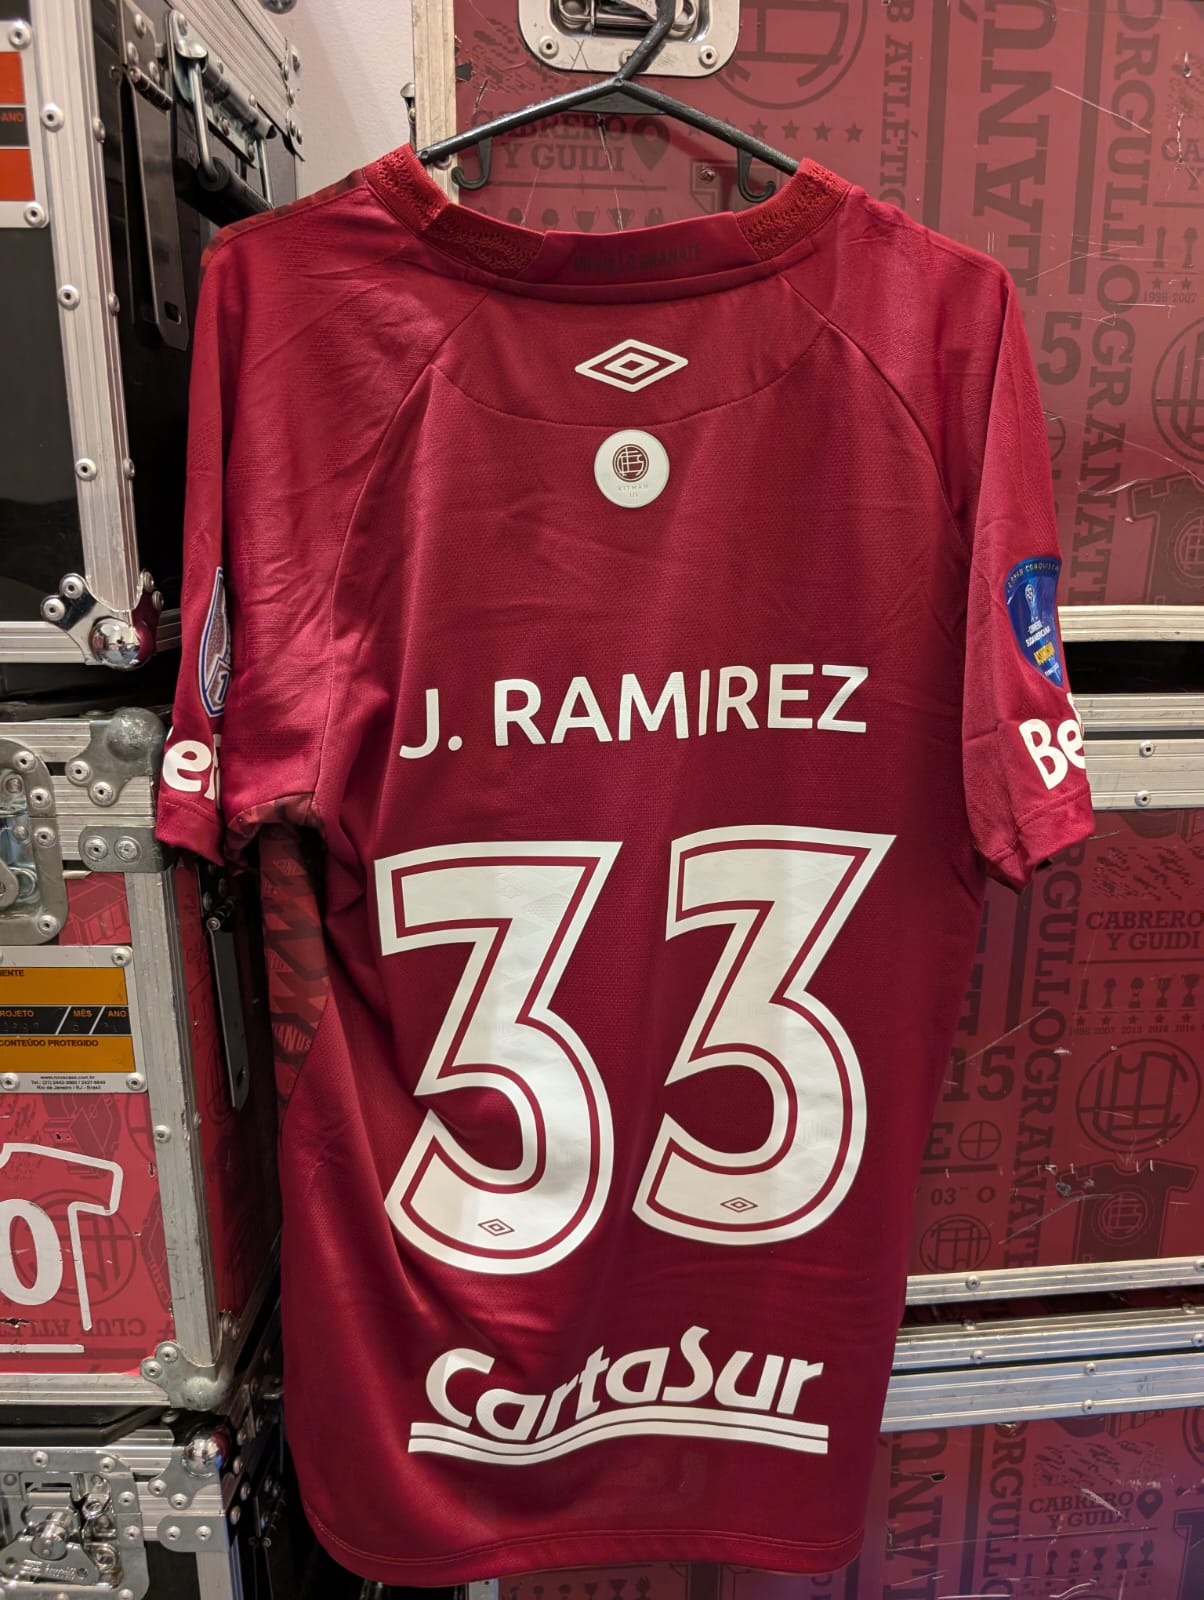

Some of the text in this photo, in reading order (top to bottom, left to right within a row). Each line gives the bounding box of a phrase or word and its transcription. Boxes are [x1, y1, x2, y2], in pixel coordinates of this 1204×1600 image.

[1, 112, 24, 122] ANO
[502, 143, 625, 171] Y GUIDI
[399, 663, 870, 760] J. RAMIREZ
[1086, 909, 1204, 931] CABRERO
[1106, 932, 1202, 950] Y GUIDI
[73, 1008, 93, 1018] MÊS
[107, 1010, 127, 1018] ANO
[48, 1039, 99, 1047] PROTEGIDO
[374, 824, 897, 1275] 33
[425, 1325, 825, 1440] CartaSur
